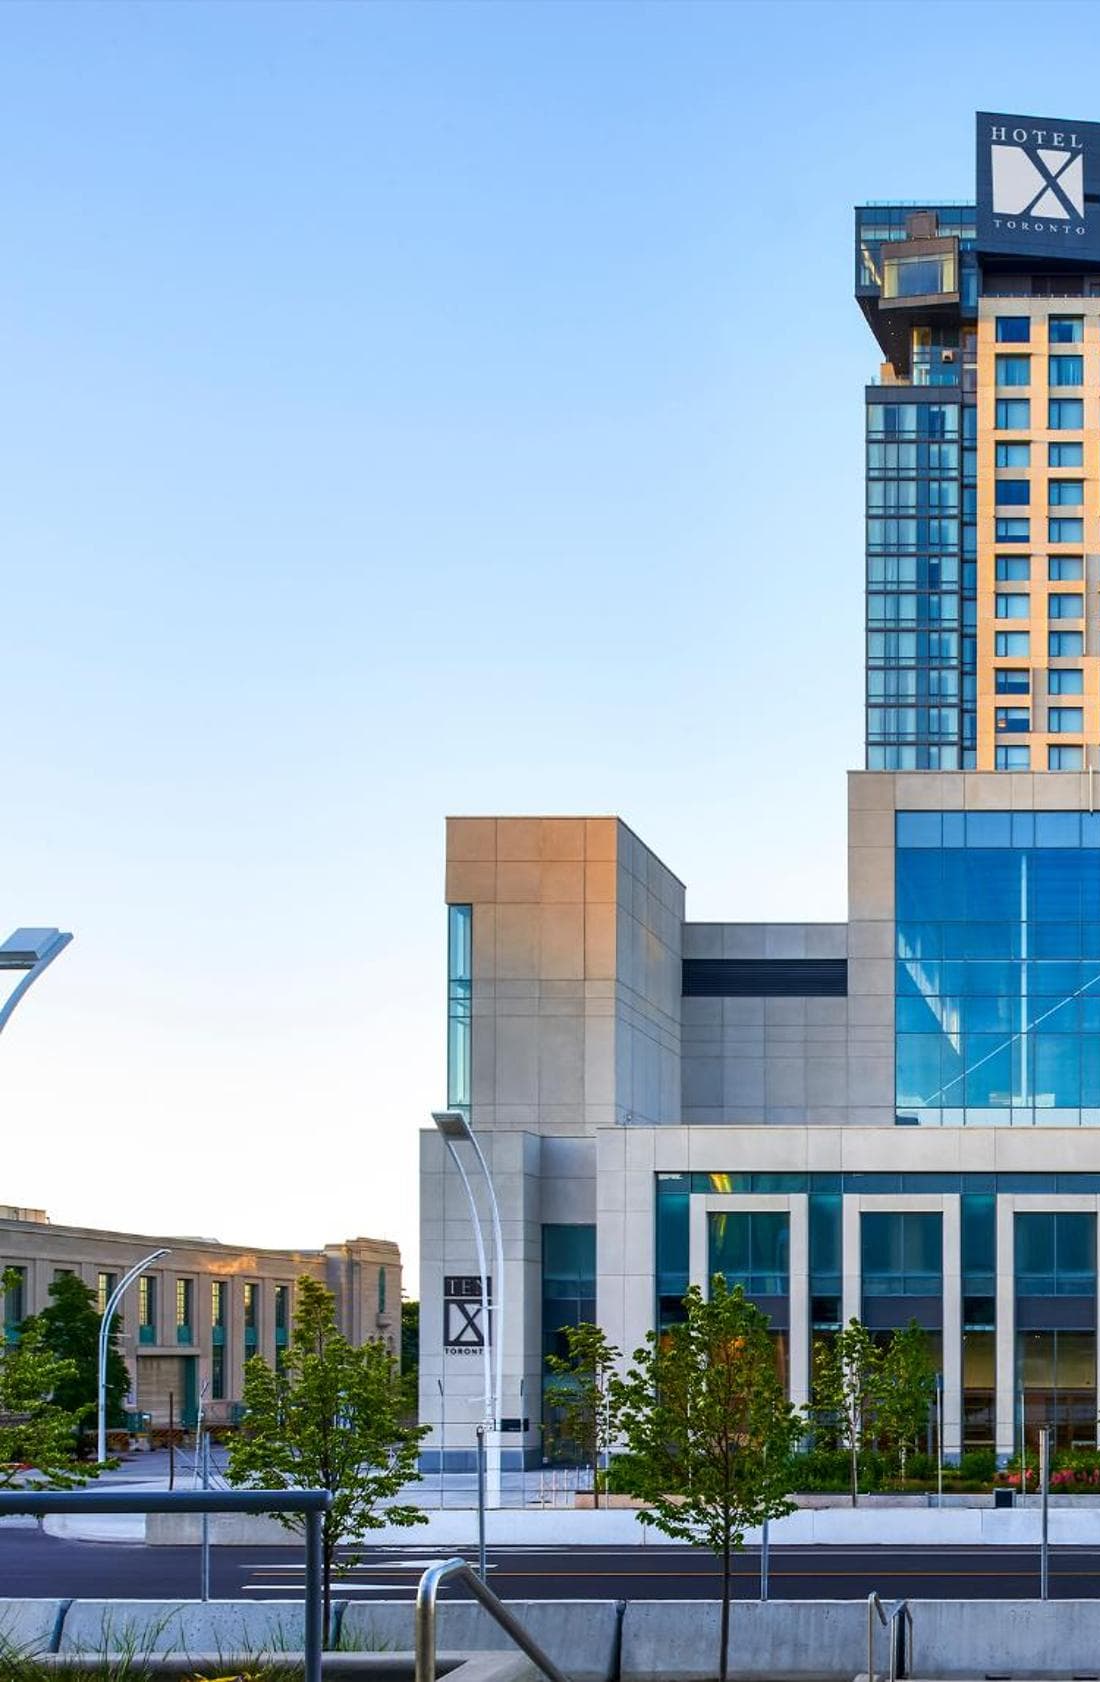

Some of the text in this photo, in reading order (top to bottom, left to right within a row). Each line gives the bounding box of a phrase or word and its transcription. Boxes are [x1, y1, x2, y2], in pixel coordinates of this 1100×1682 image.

[991, 126, 1083, 149] HOTEL
[1018, 147, 1084, 219] X
[993, 219, 1086, 235] TORONTO
[445, 1347, 487, 1355] TORONT
